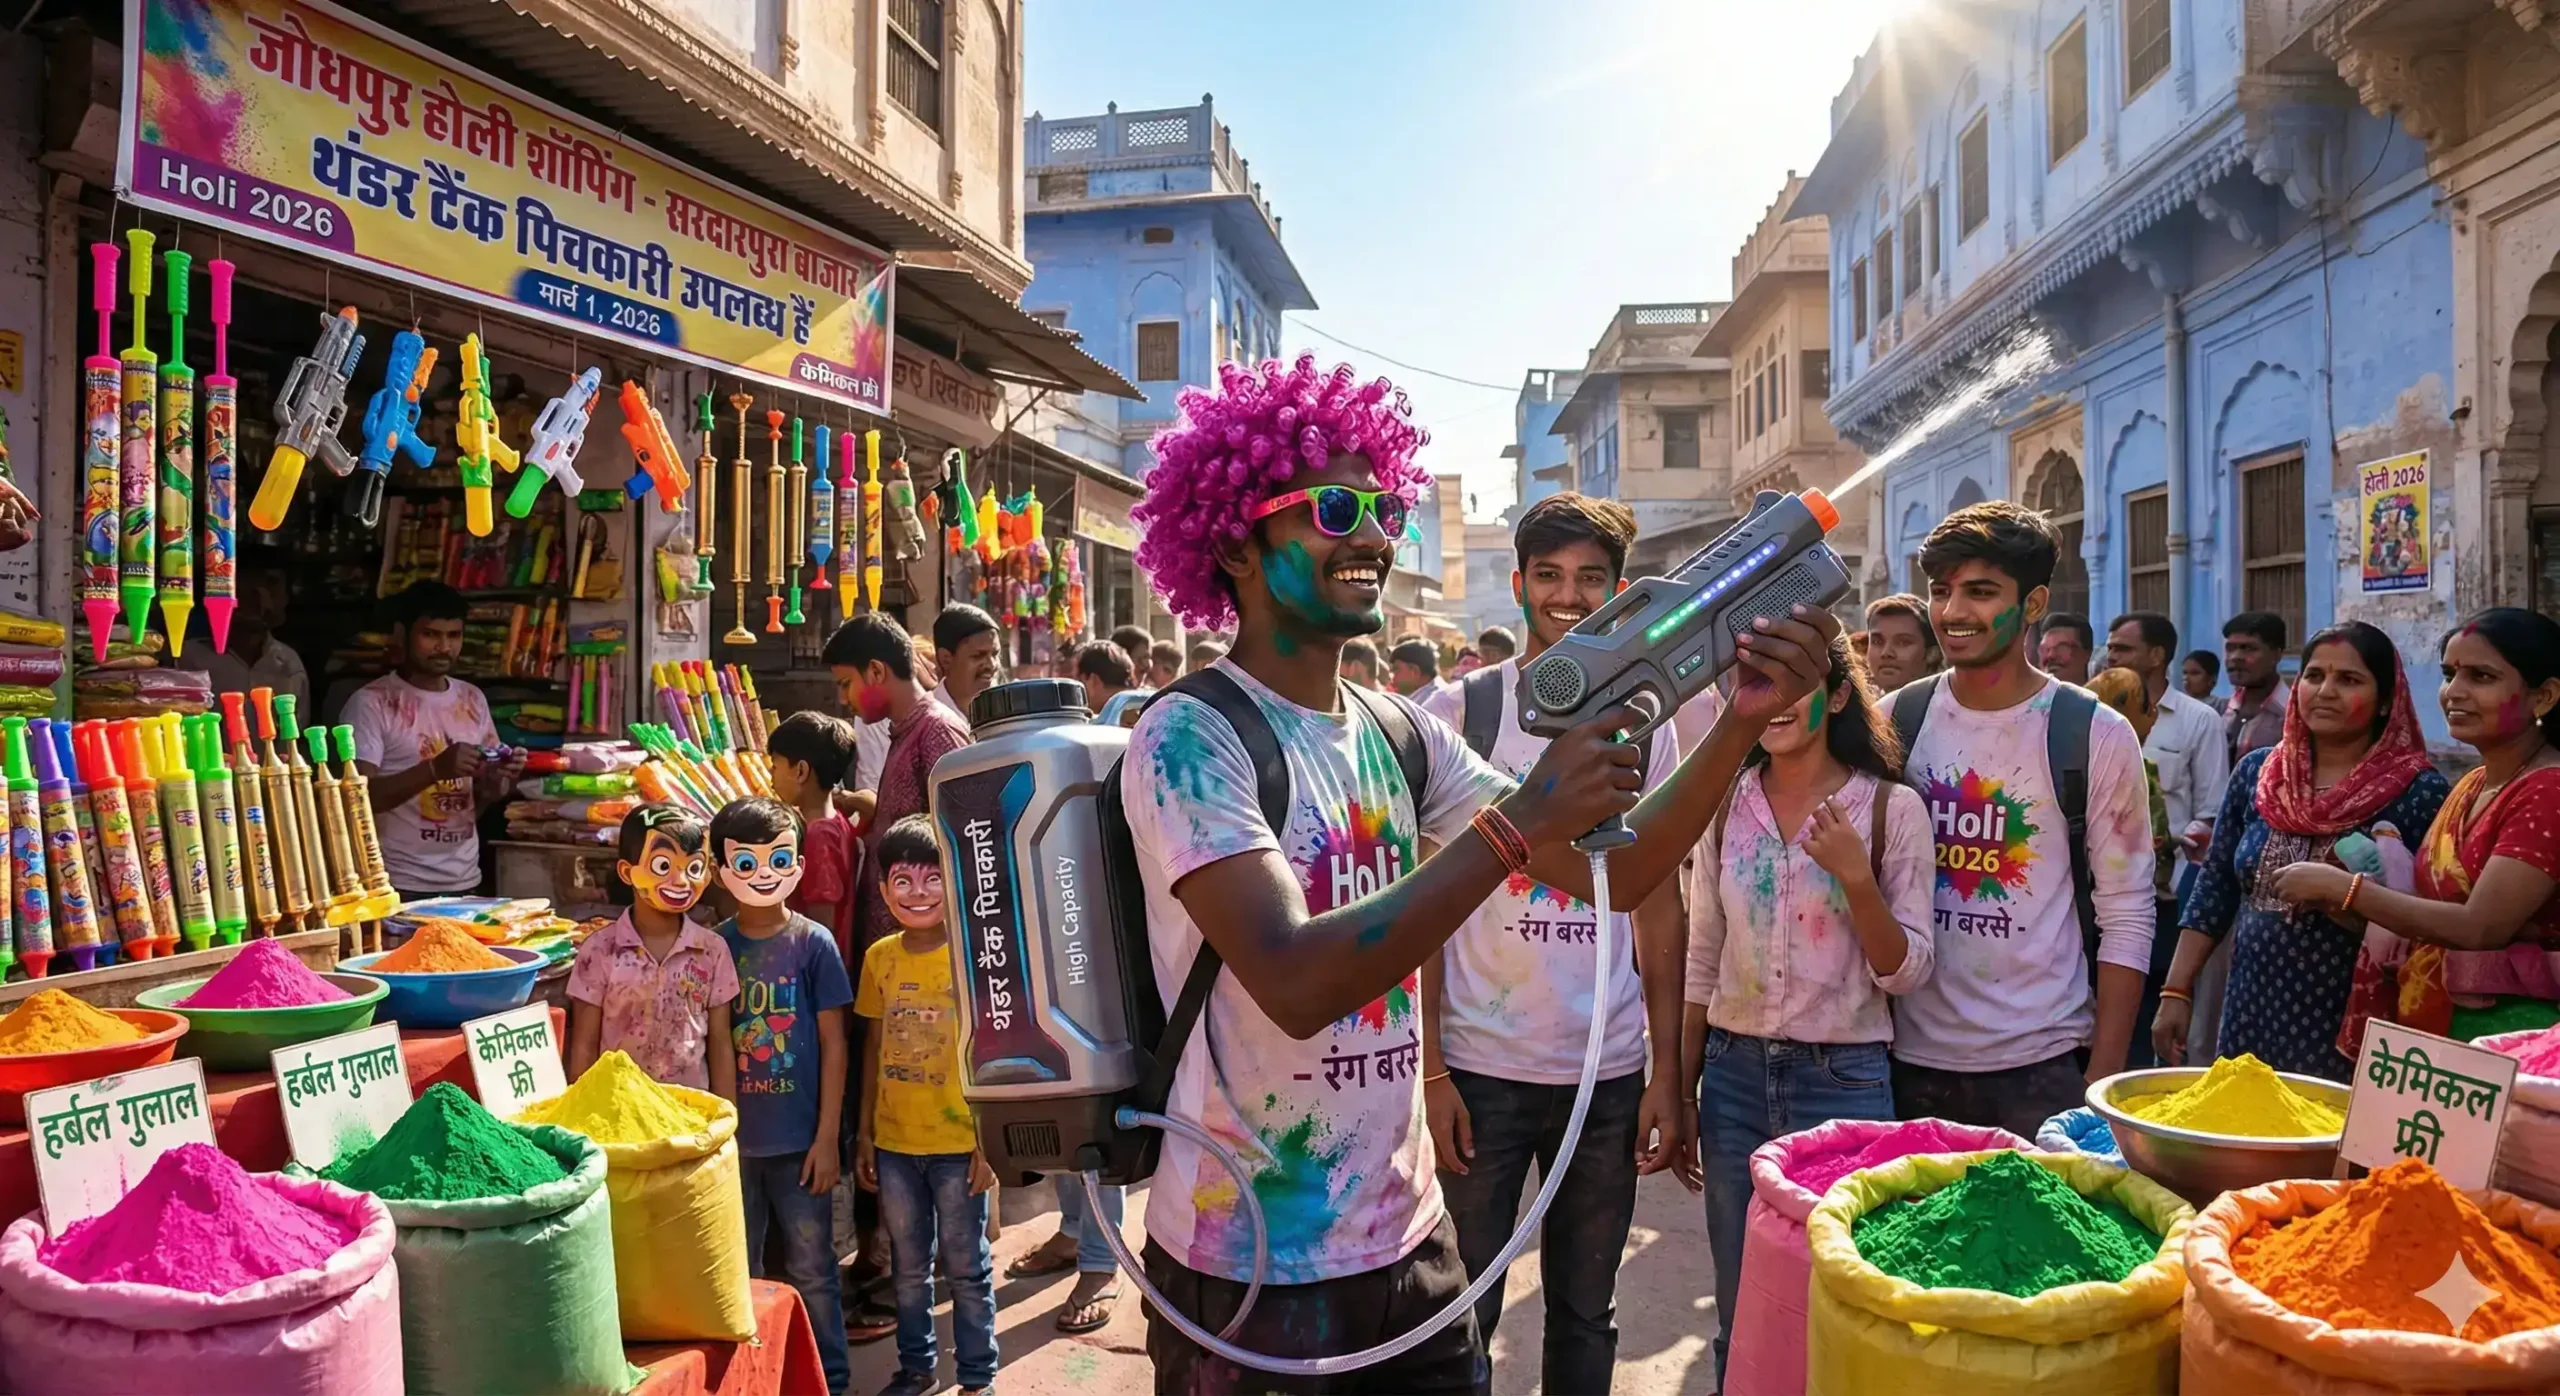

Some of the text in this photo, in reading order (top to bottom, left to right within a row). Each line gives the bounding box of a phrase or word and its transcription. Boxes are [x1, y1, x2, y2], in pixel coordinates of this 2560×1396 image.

[248, 13, 412, 136] जोधपुर
[422, 80, 518, 168] होली
[526, 127, 637, 213] शॉपिंग
[665, 189, 788, 279] सरदारपुरा
[794, 242, 859, 299] बाजार
[159, 158, 335, 237] Holi 2026
[313, 130, 815, 345] थंडर टैंक पिचकारी उपलब्ध हैं
[538, 280, 661, 336] मार्च 1, 2026
[800, 358, 859, 394] केमिकल
[2364, 464, 2425, 496] होली 2026
[1931, 800, 2006, 842] Holi
[1331, 844, 1400, 908] Holi
[1934, 843, 2000, 874] 2026
[964, 818, 1013, 1031] थंडर टैंक पिचकारी
[1055, 855, 1088, 985] High Capacity
[1518, 912, 1550, 942] रंग
[1958, 906, 2012, 939] बरसे
[476, 1021, 548, 1063] केमिकल
[1321, 1044, 1368, 1092] रंग
[283, 1043, 399, 1108] हर्बल गुलाल
[507, 1060, 536, 1099] फ्री
[2368, 1038, 2502, 1122] केमिकल
[38, 1082, 199, 1159] हर्बल गुलाल
[2392, 1109, 2445, 1165] फ्री
